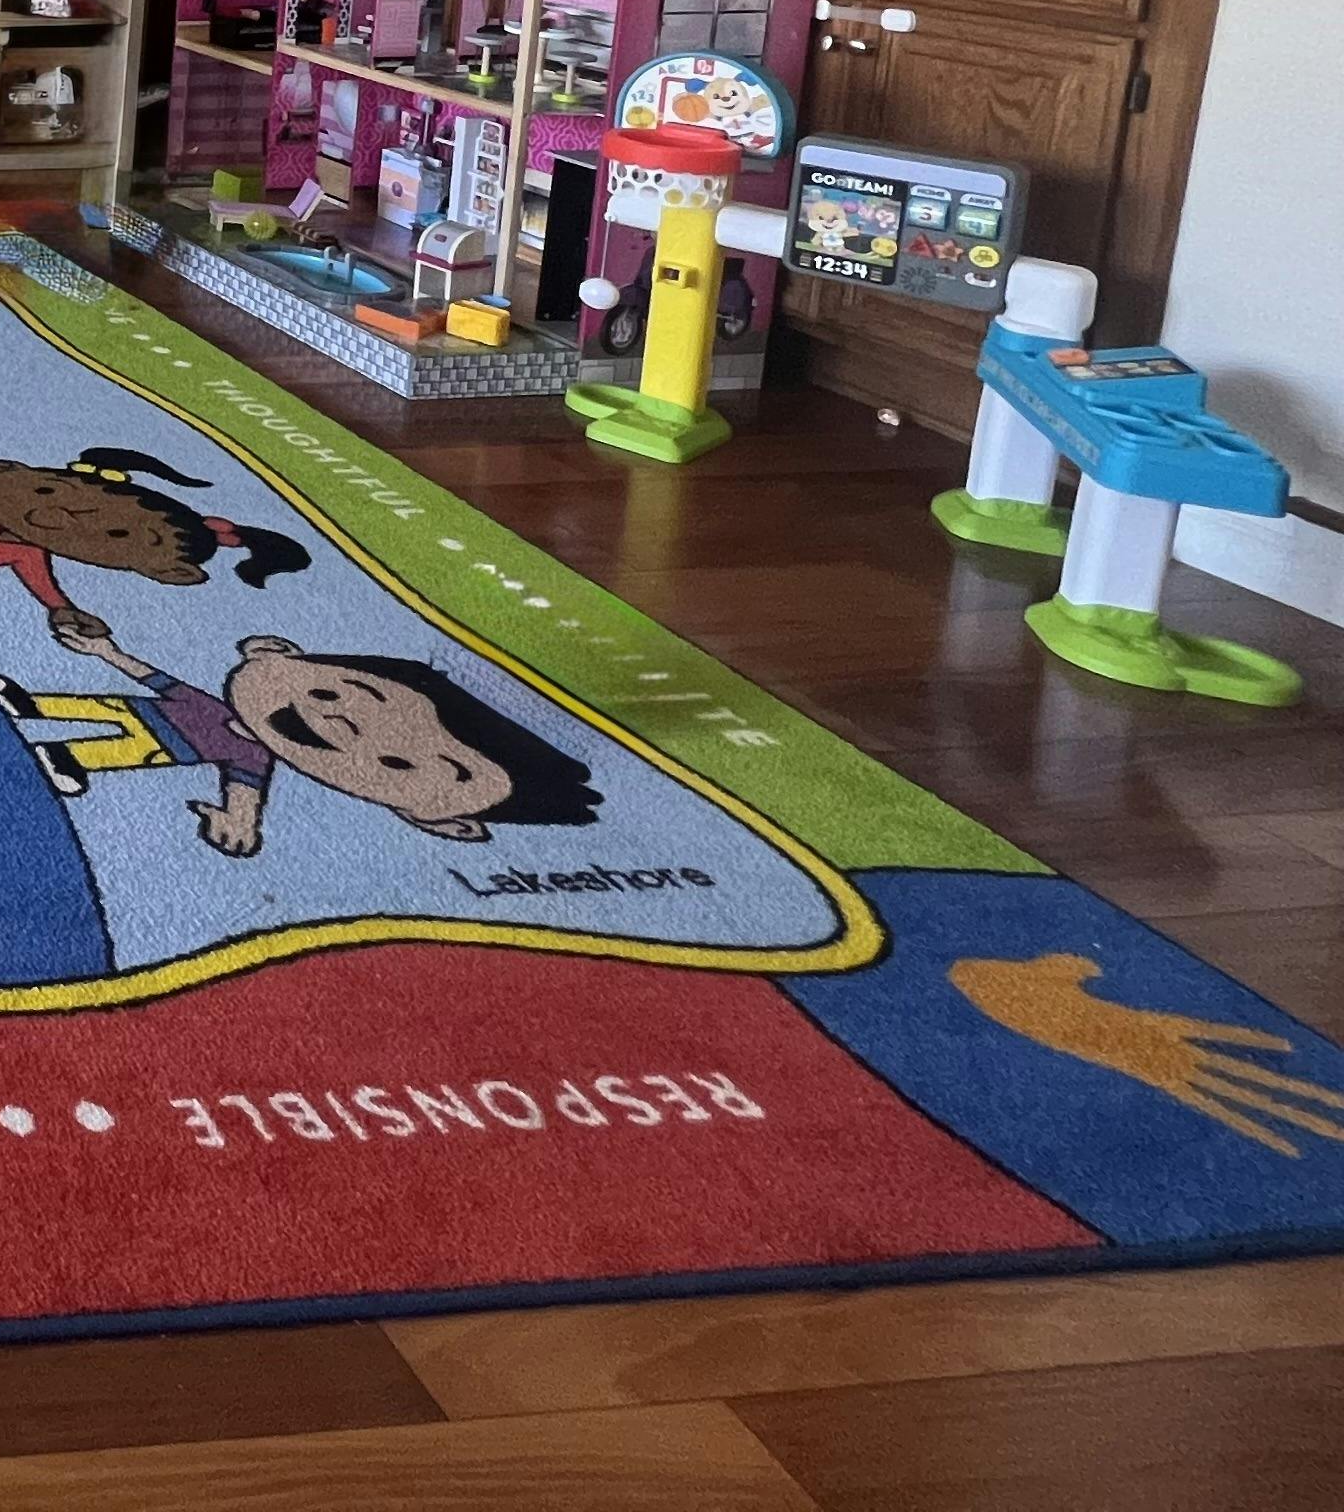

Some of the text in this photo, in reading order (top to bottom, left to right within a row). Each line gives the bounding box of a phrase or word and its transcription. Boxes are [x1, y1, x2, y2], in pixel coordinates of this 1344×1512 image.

[631, 90, 654, 103] 123
[811, 172, 894, 196] GO TEAM!
[814, 255, 868, 279] 12:34
[203, 379, 425, 520] THOUGHTFUL
[447, 863, 716, 898] Lakeshore
[169, 1071, 766, 1149] RESPONSIBLE
